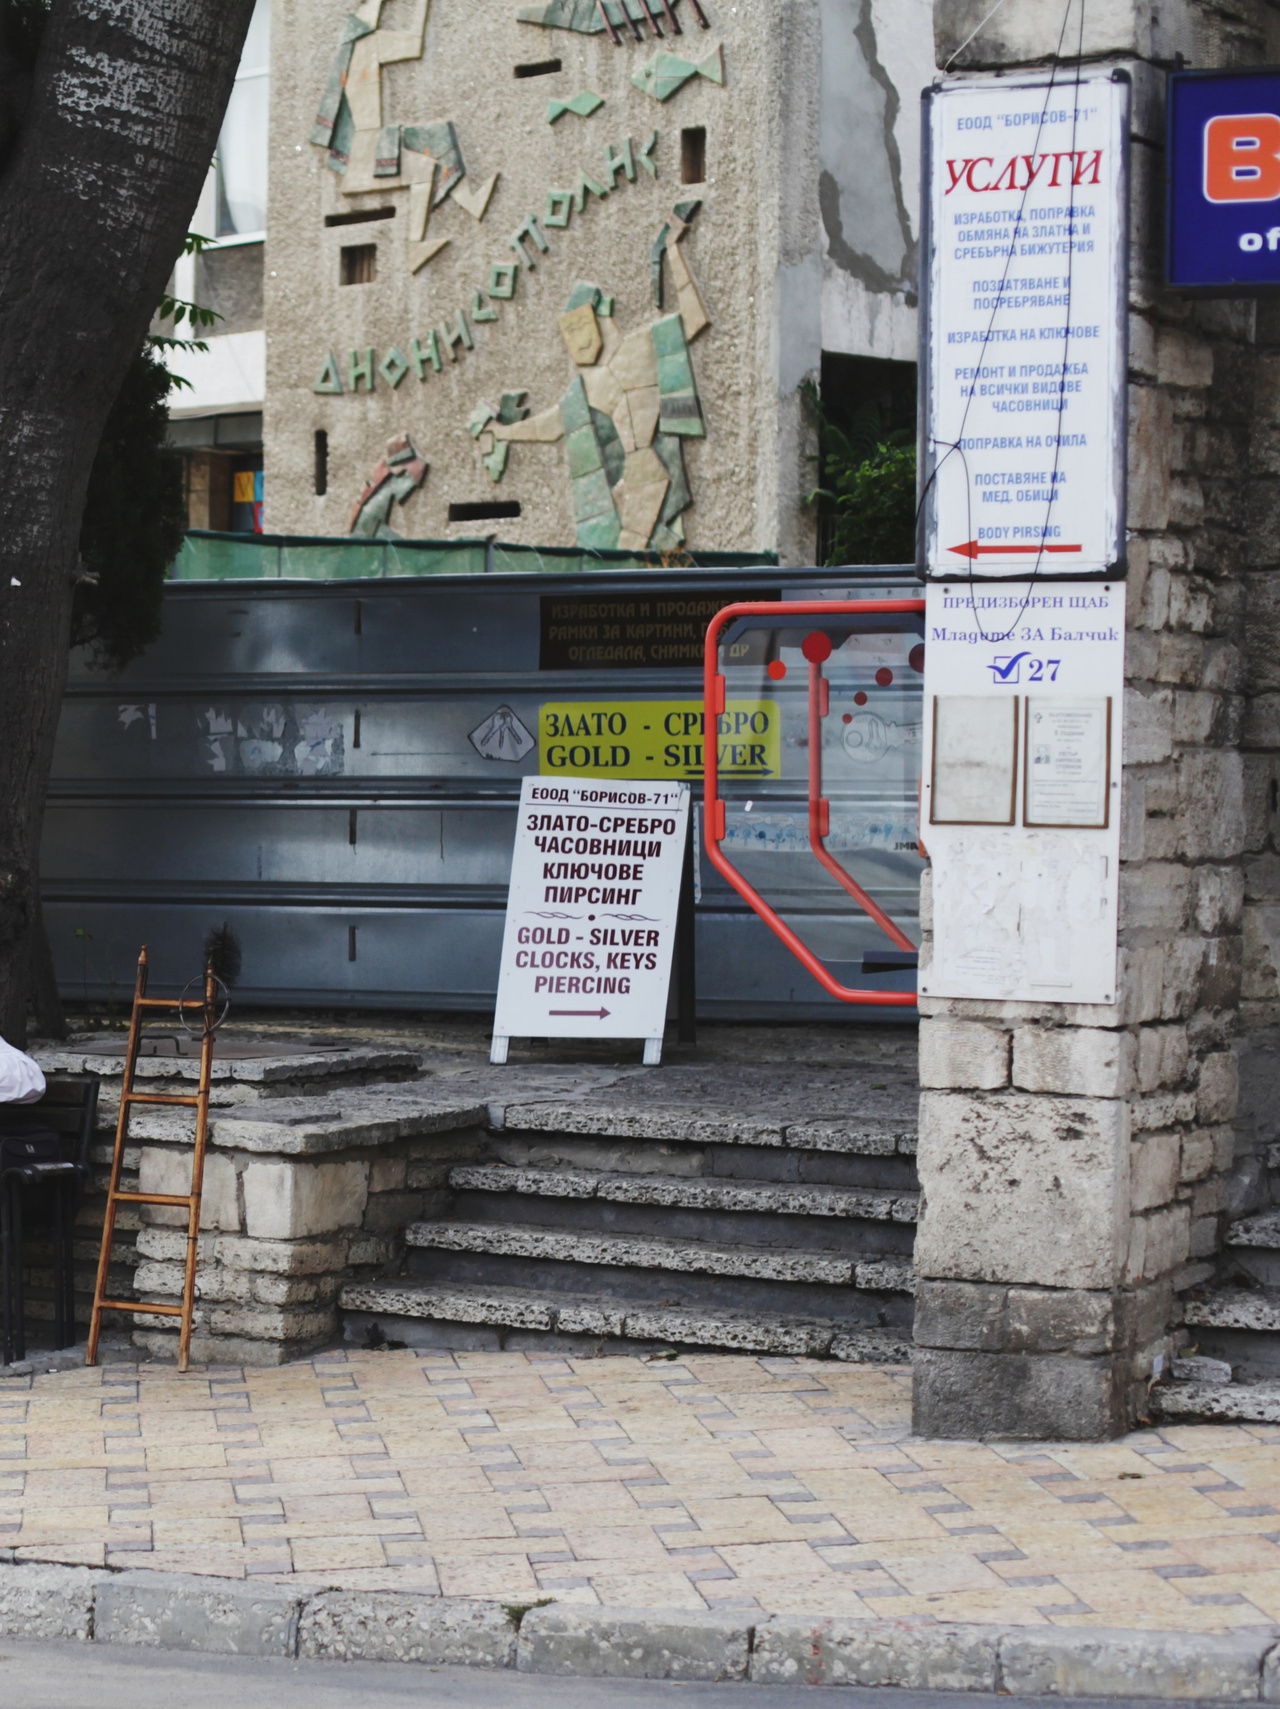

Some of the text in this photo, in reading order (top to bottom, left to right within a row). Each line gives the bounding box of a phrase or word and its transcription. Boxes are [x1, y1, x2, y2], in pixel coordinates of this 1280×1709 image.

[957, 116, 993, 131] ЕООД
[944, 150, 1104, 195] УСЛУГИ
[954, 205, 1096, 226] ИЗРАБОТКА, ПОПРАВКА
[958, 223, 1091, 242] ОБМЯНА НА ЗЛАТНА И
[954, 240, 1094, 260] СРЕБЪРНА БИЖУТЕРИЯ
[973, 276, 1071, 293] ПОЗЛАТЯВАНЕ И
[974, 293, 1071, 310] ПОСРЕБРЯВАНЕ
[947, 325, 1100, 344] ИЗРАБОТКА НА КЛЮЧОВЕ
[954, 362, 1089, 380] РЕМОНТ И ПРОДАЖБА
[960, 380, 1082, 397] НА ВСИЧКИ ВИДОВЕ
[992, 398, 1069, 413] ЧАСОВНИЦИ
[959, 433, 1087, 450] ПОПРАВКА НА ОЧИЛА
[975, 471, 1067, 486] ПОСТАВЯНЕ НА
[982, 489, 1059, 503] МЕД. ОБИЦИ
[978, 525, 1061, 539] BODY PIRSING
[552, 602, 636, 619] ИЗРАБОТКА
[640, 602, 650, 617] И
[943, 596, 1109, 611] ПРЕДИЗБОРЕН ЩАБ
[549, 625, 598, 641] РАМКИ
[603, 624, 619, 639] ЗА
[931, 626, 1119, 644] Младите ЗА Балчик
[1028, 659, 1062, 682] 27
[545, 712, 627, 738] ЗЛАТО
[546, 745, 631, 767] GOLD
[531, 787, 570, 802] ЕООД
[526, 814, 676, 835] ЗЛАТО-СРЕБРО
[534, 836, 662, 859] ЧАСОВНИЦИ
[542, 862, 644, 881] КЛЮЧОВЕ
[544, 886, 643, 905] ПИРСИНГ
[517, 926, 570, 945] GOLD
[589, 928, 660, 947] SILVER
[515, 950, 657, 972] CLOCKS, KEYS
[534, 976, 631, 995] PIERCING
